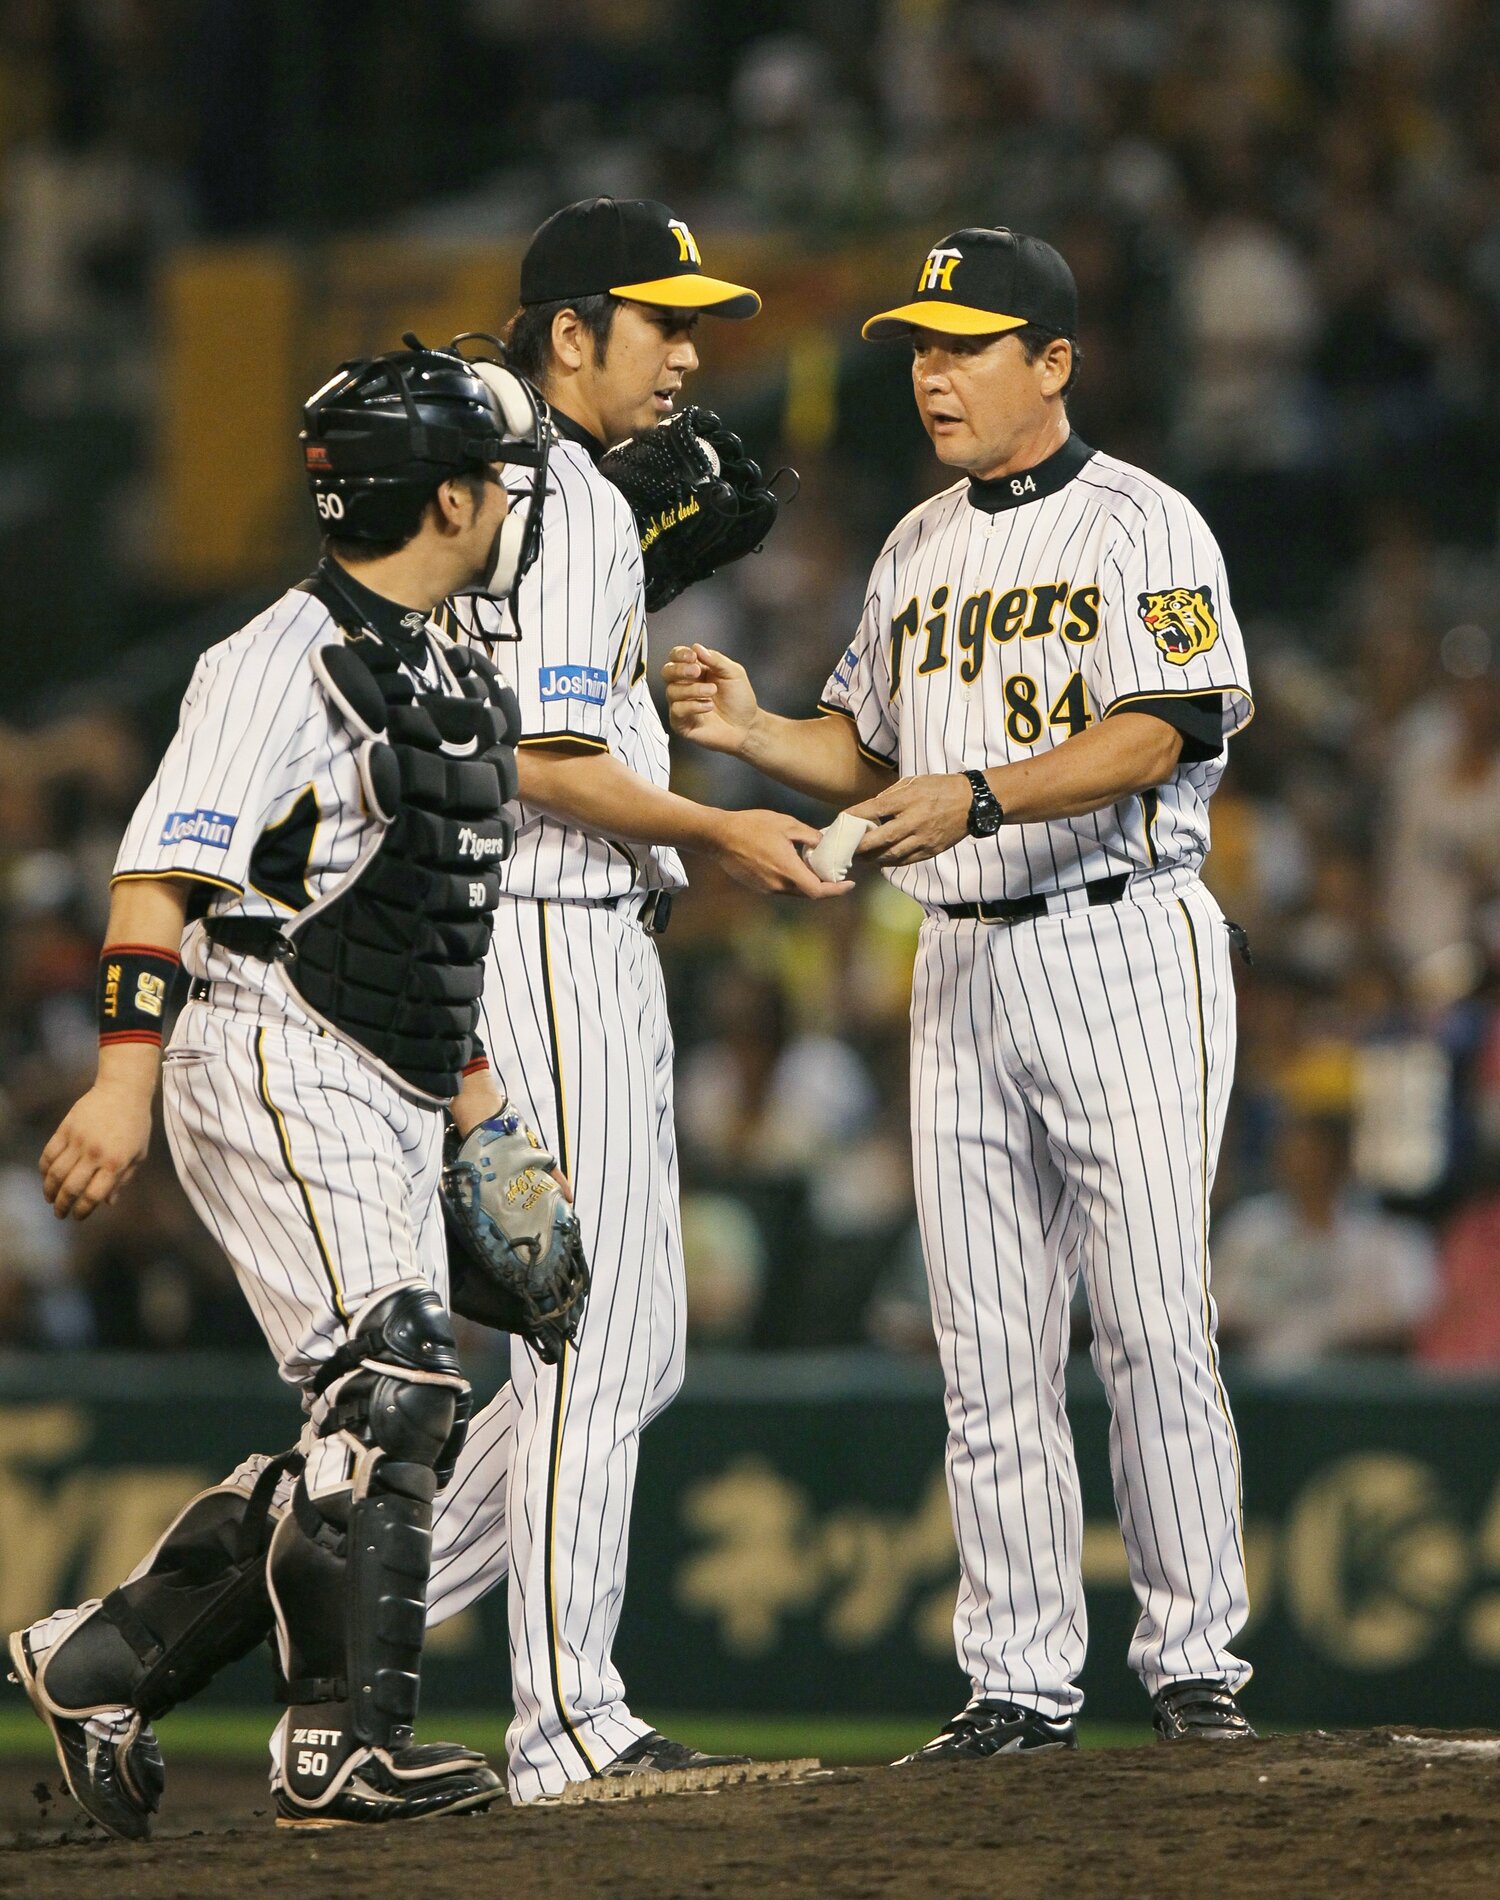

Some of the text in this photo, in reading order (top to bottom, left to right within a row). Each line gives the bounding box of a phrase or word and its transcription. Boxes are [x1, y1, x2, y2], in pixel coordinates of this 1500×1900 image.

[1010, 474, 1037, 496] 84
[316, 492, 345, 520] 50
[887, 581, 1102, 704] Tigers
[541, 670, 607, 700] Joshin
[1003, 671, 1095, 746] 84
[162, 812, 232, 844] Joshin
[458, 827, 503, 861] Tigers
[468, 882, 487, 908] 50
[104, 964, 122, 1018] ZETT
[135, 971, 166, 1018] 50
[291, 1728, 343, 1747] ZETT
[296, 1750, 329, 1777] 50
